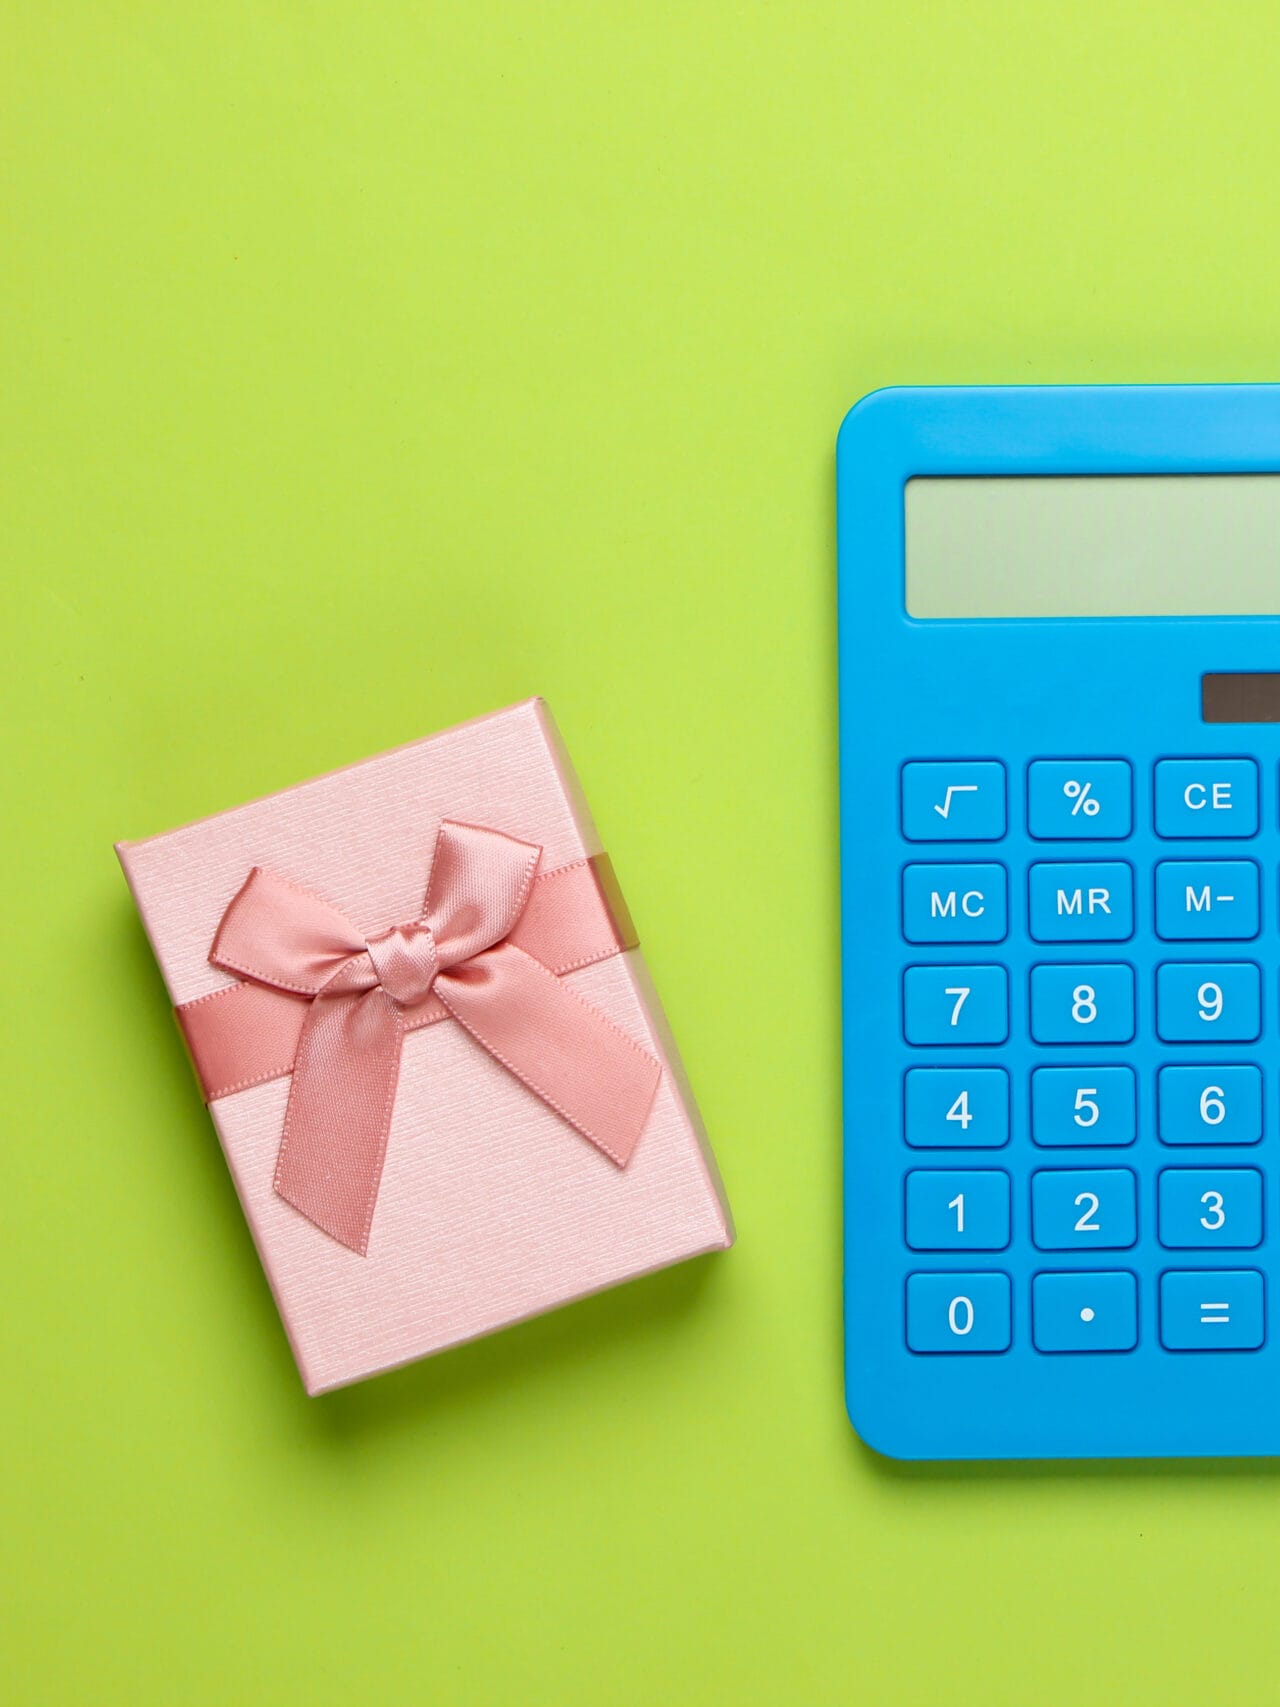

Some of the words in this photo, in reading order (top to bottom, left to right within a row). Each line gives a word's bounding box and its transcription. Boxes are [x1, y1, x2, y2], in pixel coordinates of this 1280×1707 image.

[1063, 780, 1100, 816] %
[1184, 783, 1233, 810] CE
[931, 890, 985, 918] MC
[1057, 888, 1111, 915] MR
[945, 987, 971, 1026] 7
[1071, 984, 1097, 1024] 8
[1197, 982, 1223, 1021] 9
[946, 1090, 973, 1129] 4
[1073, 1088, 1100, 1127] 5
[1199, 1085, 1226, 1125] 6
[948, 1193, 964, 1232] 1
[1074, 1192, 1100, 1231] 2
[1200, 1190, 1226, 1230] 3
[948, 1296, 974, 1335] 0
